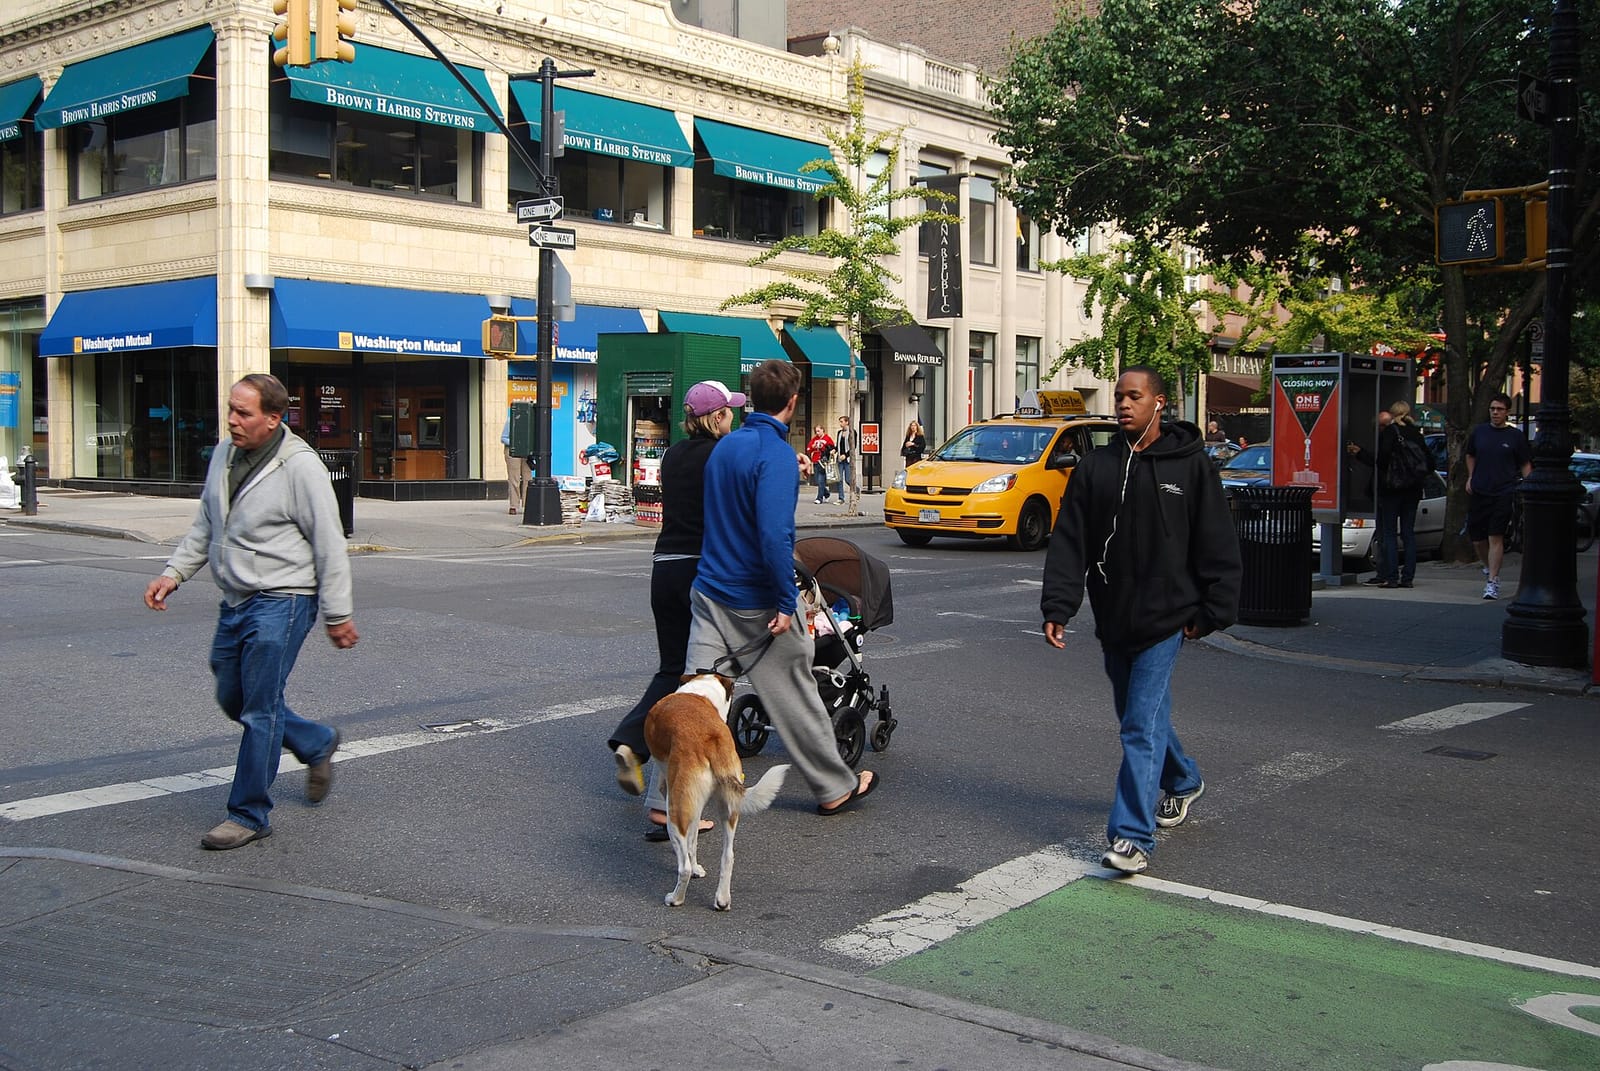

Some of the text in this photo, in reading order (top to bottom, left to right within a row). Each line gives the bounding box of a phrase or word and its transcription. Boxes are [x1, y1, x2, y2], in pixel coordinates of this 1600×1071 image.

[62, 90, 157, 124] BROWN HARRIS STEVENS
[327, 88, 475, 128] BROWN HARRIS STEVENS
[563, 134, 672, 164] ROWN HARRIS STEVENS
[735, 166, 823, 192] BROWN HARRIS STEVE
[522, 204, 558, 216] ONE WAY
[535, 231, 570, 243] ONE WAY
[83, 333, 152, 352] Washington Mutual
[354, 335, 461, 353] Washington Mutual
[894, 352, 942, 364] BANANA REPUBLIC
[1213, 354, 1228, 372] LA
[321, 386, 335, 395] 129
[512, 383, 564, 395] Save fo big
[1296, 395, 1320, 404] ONE
